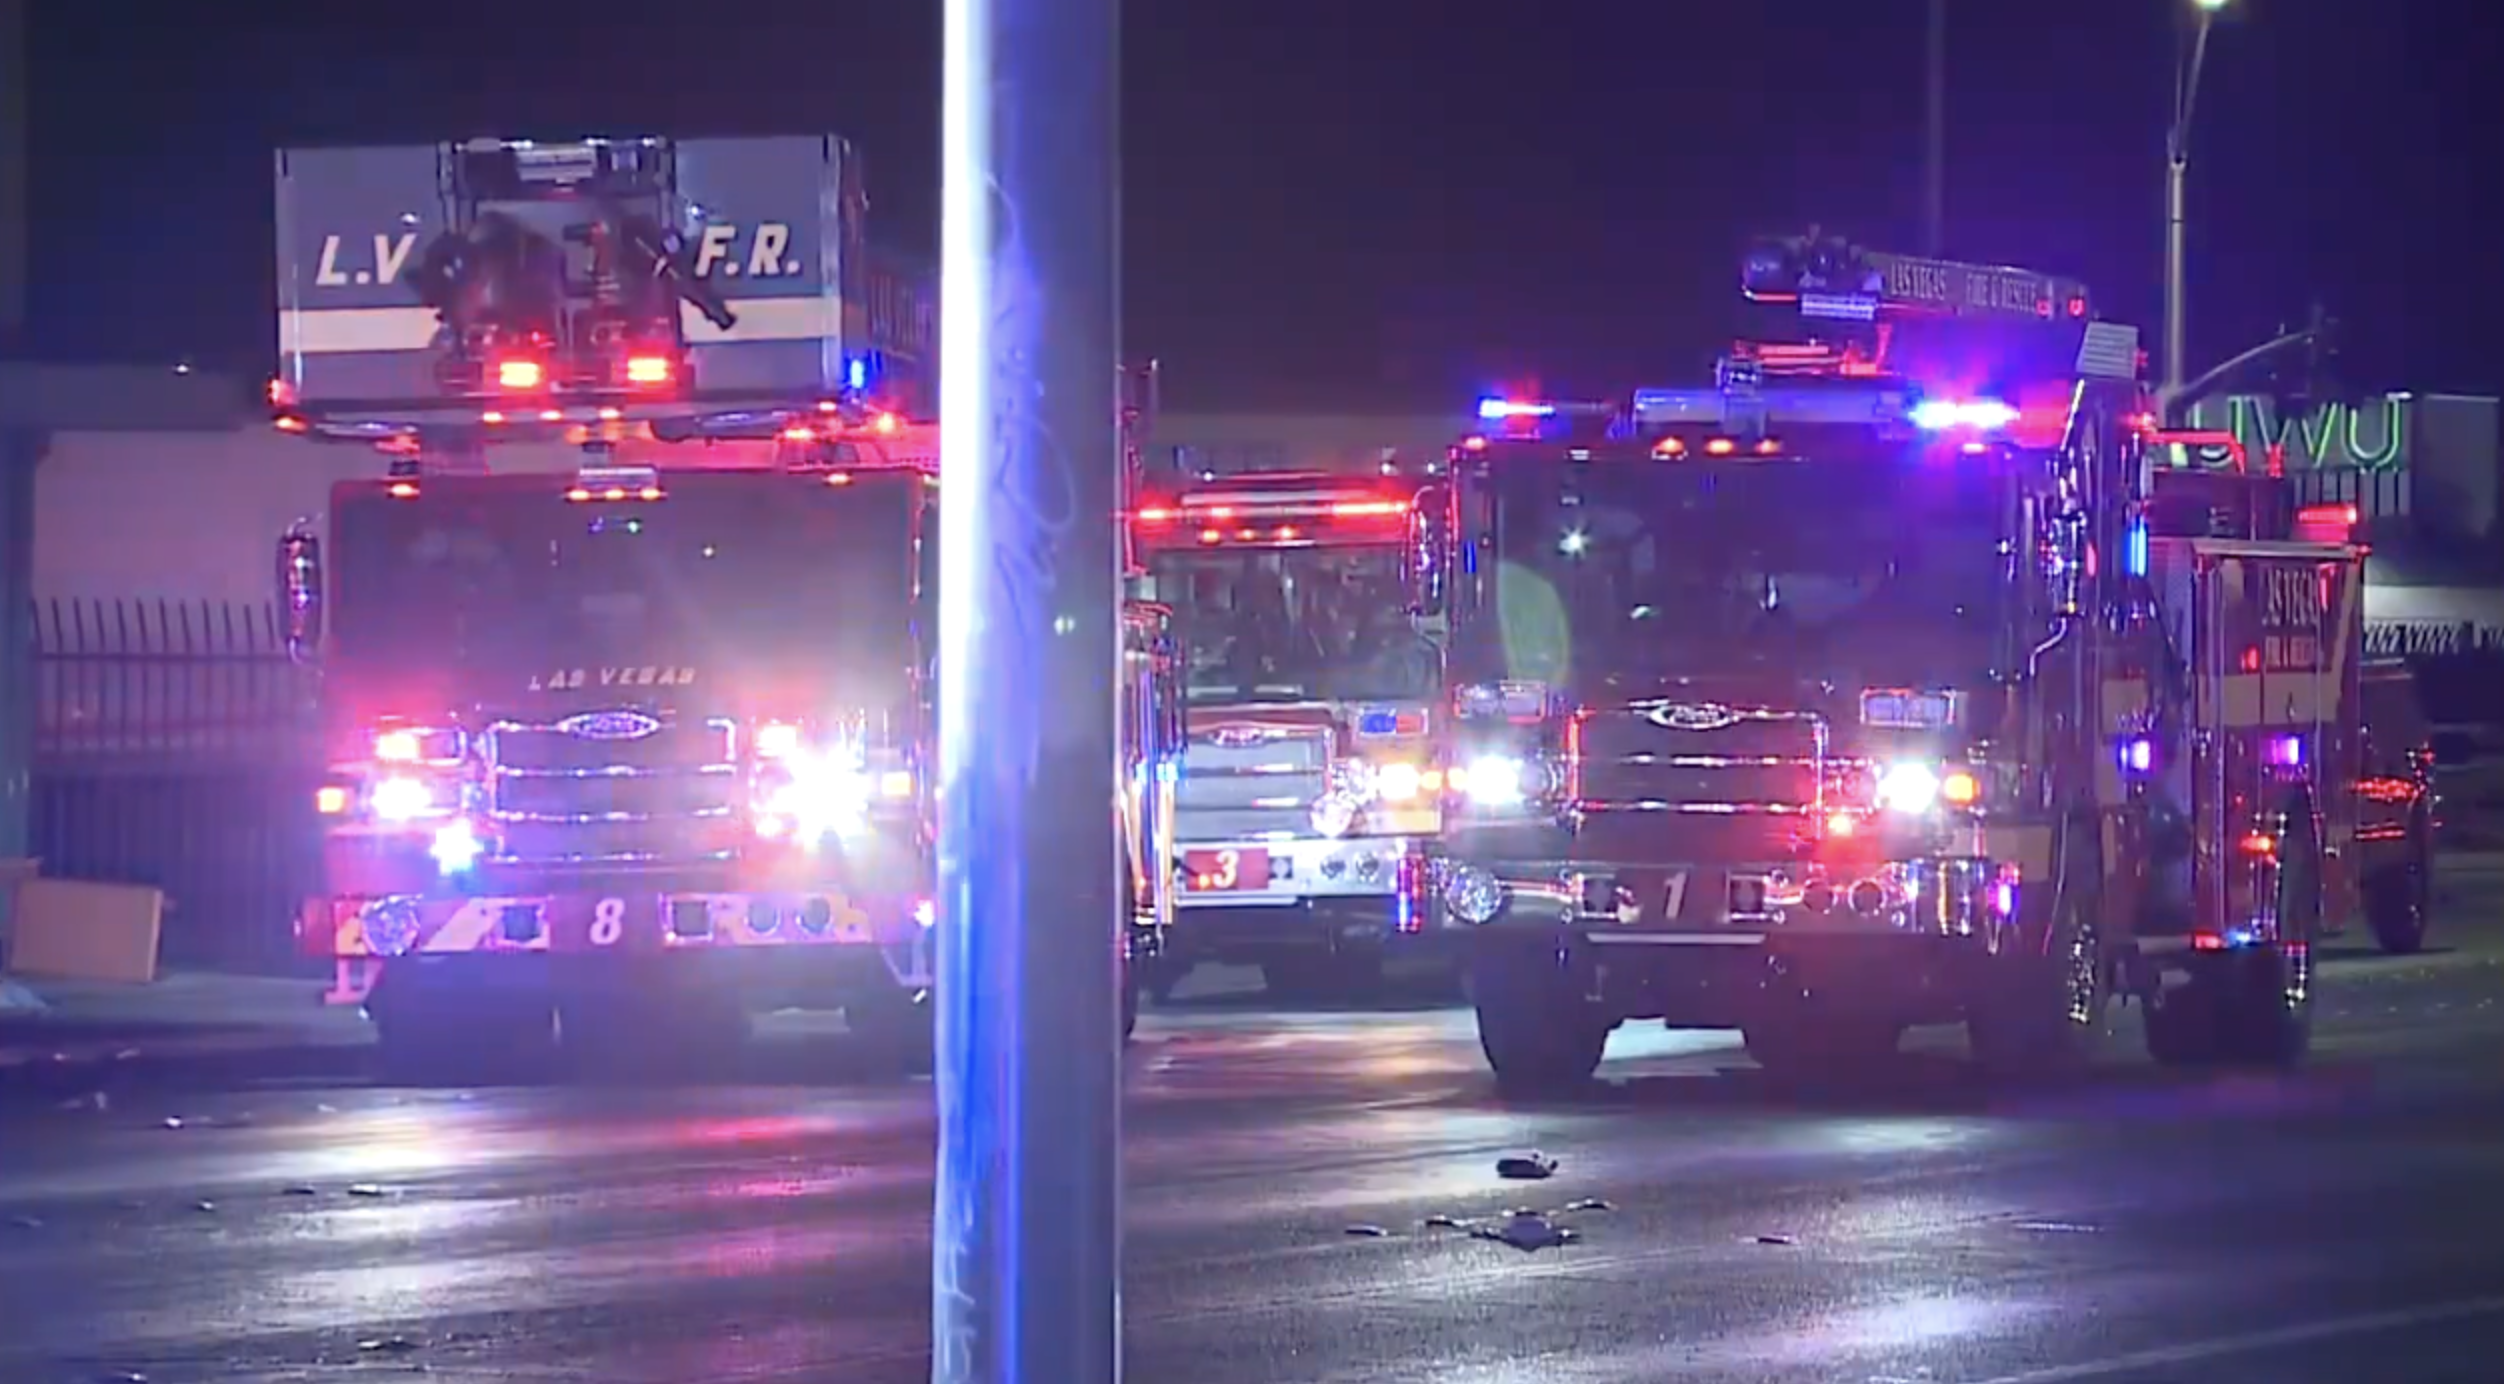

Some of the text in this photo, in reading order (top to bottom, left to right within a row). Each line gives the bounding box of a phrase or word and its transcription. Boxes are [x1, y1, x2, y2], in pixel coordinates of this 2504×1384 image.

[694, 222, 801, 277] F.R.
[527, 666, 696, 692] LAS VEGAS
[1212, 850, 1240, 889] 3
[1664, 871, 1687, 919] 1
[589, 897, 626, 945] 8
